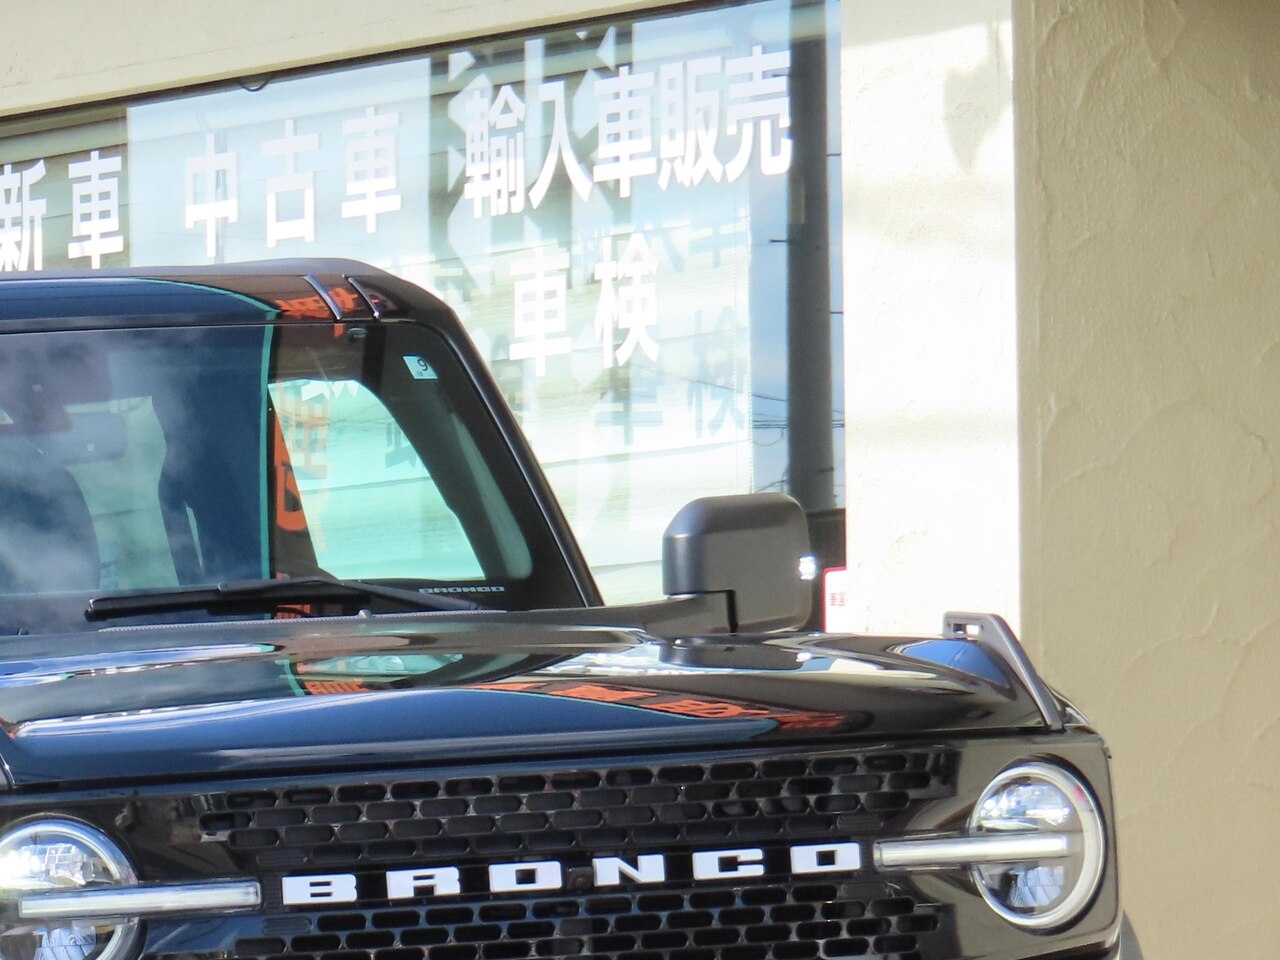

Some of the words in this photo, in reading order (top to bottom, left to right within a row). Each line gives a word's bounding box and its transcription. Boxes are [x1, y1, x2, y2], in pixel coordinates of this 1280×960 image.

[184, 106, 402, 258] 中古車
[464, 45, 793, 219] 輸入車販売
[509, 232, 660, 377] 車検
[281, 841, 861, 906] BRONCO
